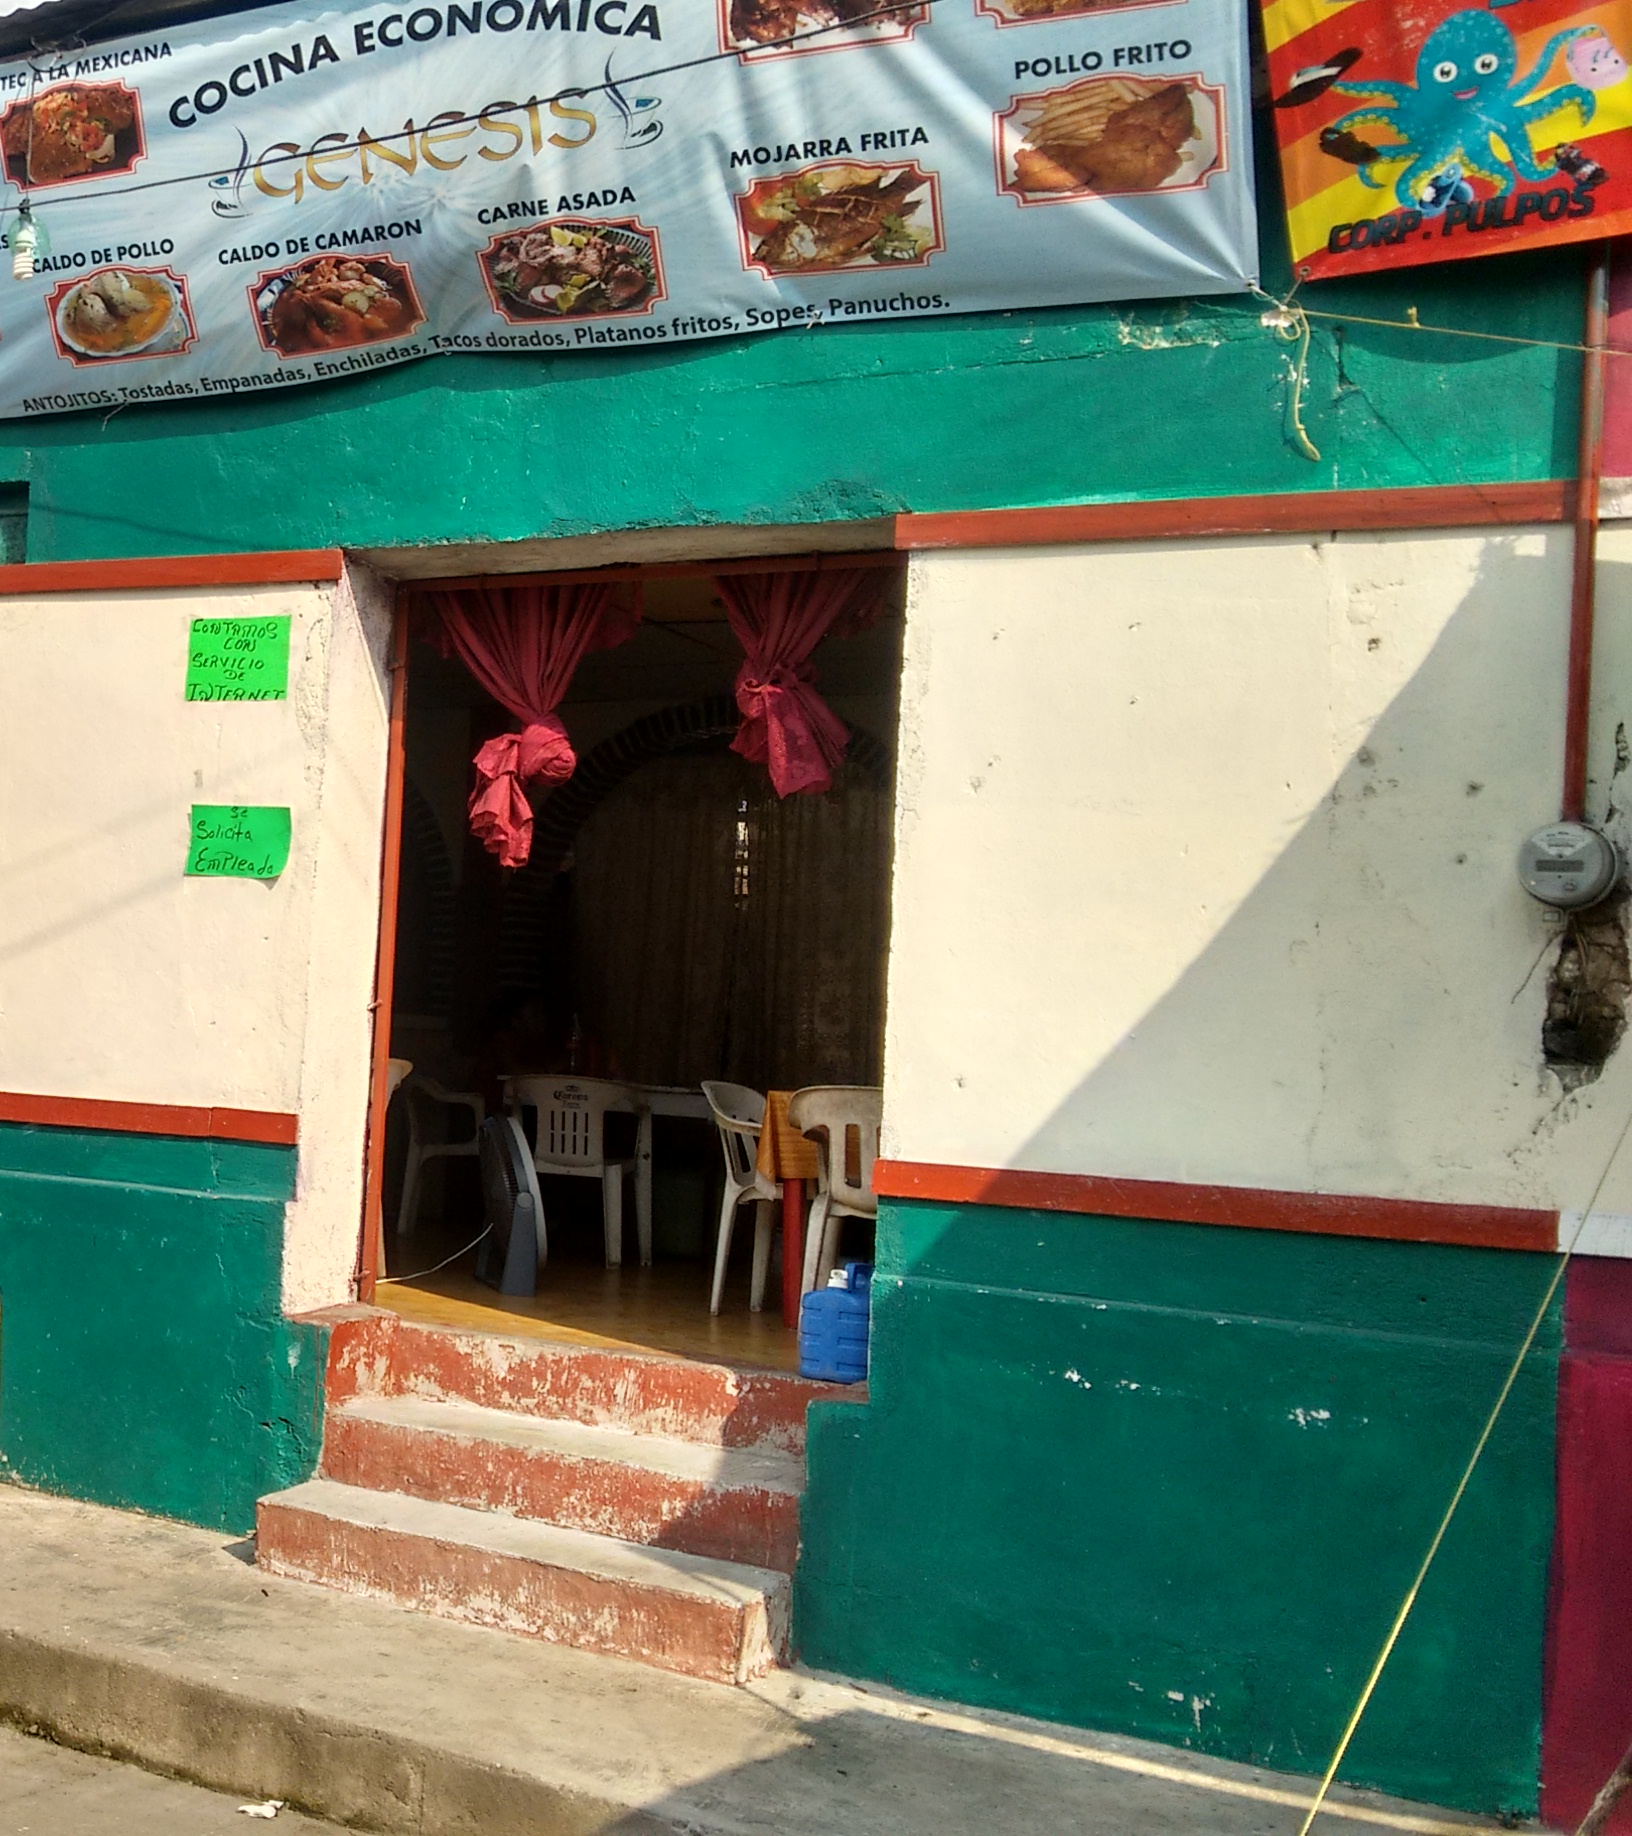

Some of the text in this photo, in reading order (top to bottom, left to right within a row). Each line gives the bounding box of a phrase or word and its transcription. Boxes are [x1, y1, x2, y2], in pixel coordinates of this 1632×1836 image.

[31, 71, 44, 84] A
[49, 65, 70, 80] LA
[75, 42, 172, 77] MEXICANA
[168, 0, 663, 128] COCINA ECONOMICA
[1013, 39, 1193, 80] POLLO FRITO
[252, 87, 597, 205] GENESIS
[729, 126, 930, 168] MOJARRA FRITA
[477, 185, 637, 226] CARNE ASADA
[1441, 183, 1597, 237] PULPOS
[32, 238, 175, 274] CALDO DE POLLO
[218, 219, 423, 266] CALDO DE CAMARON
[22, 291, 950, 413] ANTOJITOS: Tostadas, Empanadas, Enchiladas, Tacos dorados, Platanos fritos, Sopes, Panuchos.
[187, 683, 286, 701] INTERNET
[196, 820, 253, 842] Solicita
